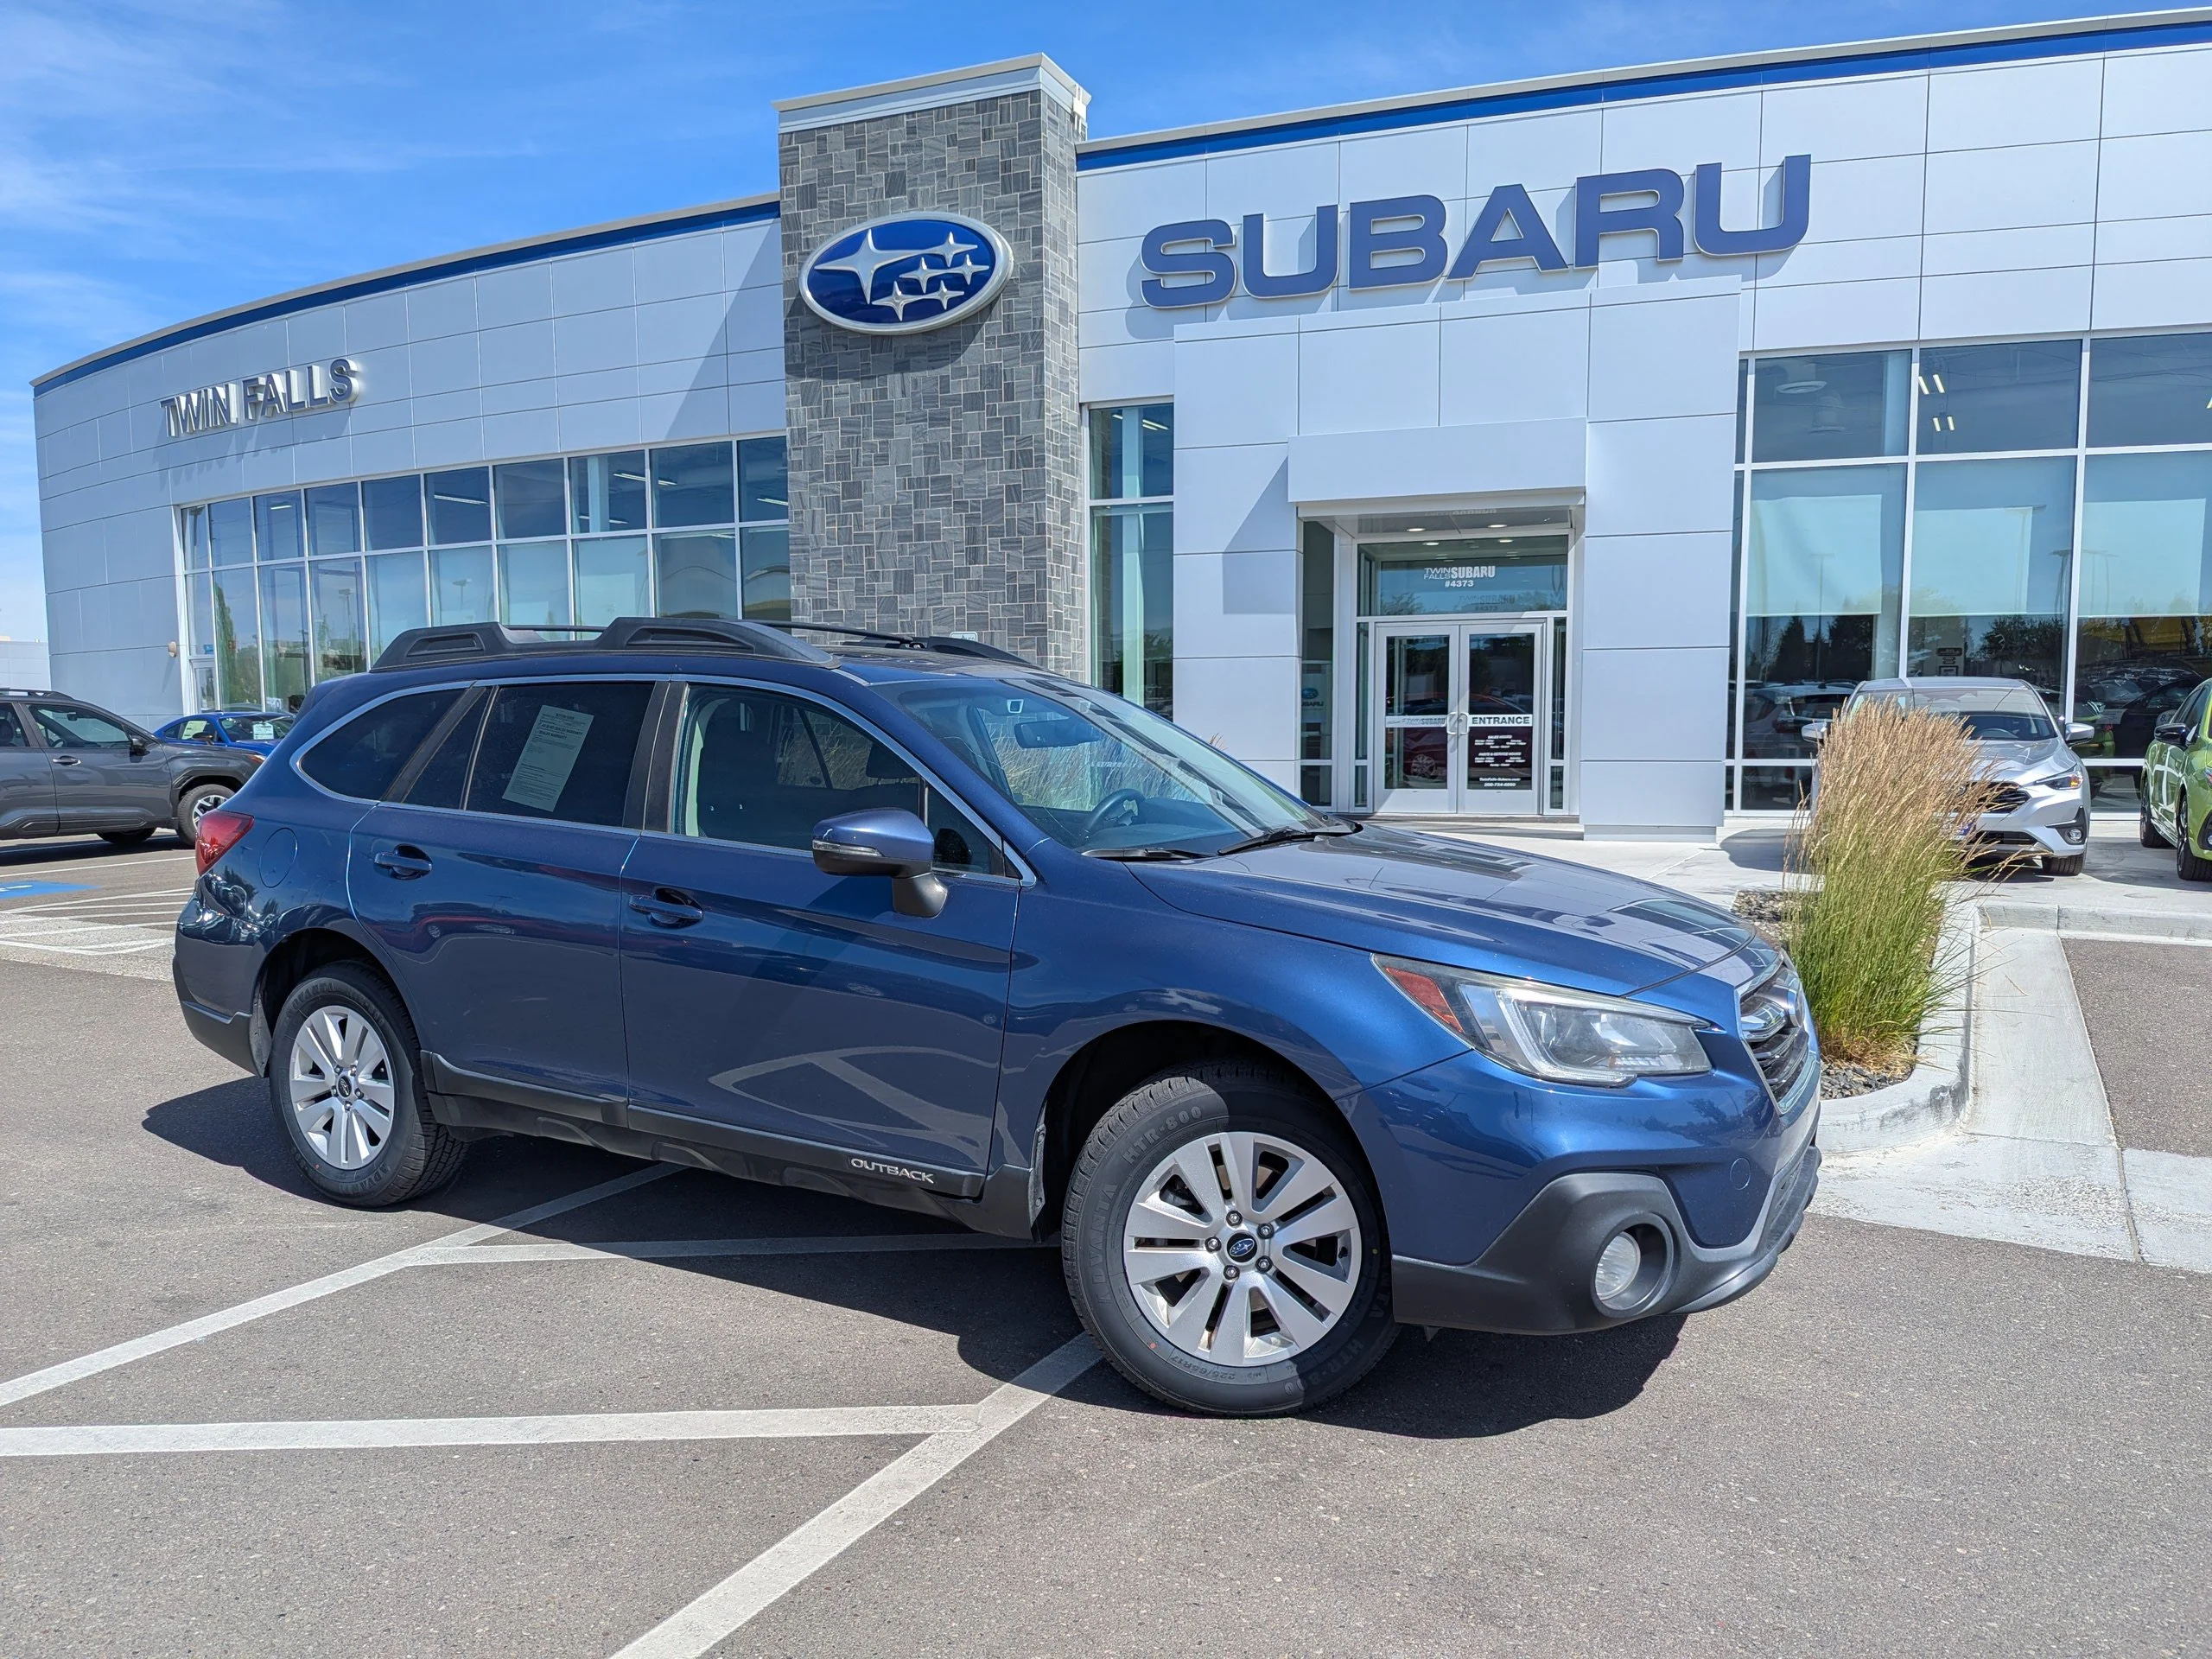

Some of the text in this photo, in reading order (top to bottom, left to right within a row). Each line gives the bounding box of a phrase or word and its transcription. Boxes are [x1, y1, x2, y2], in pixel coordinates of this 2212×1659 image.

[1141, 154, 1812, 308] SUBARU
[160, 358, 358, 437] TWIN FALLS
[1451, 566, 1497, 579] SUBARU
[1471, 716, 1530, 725] ENTRANCE
[851, 1158, 934, 1184] OUTBACK
